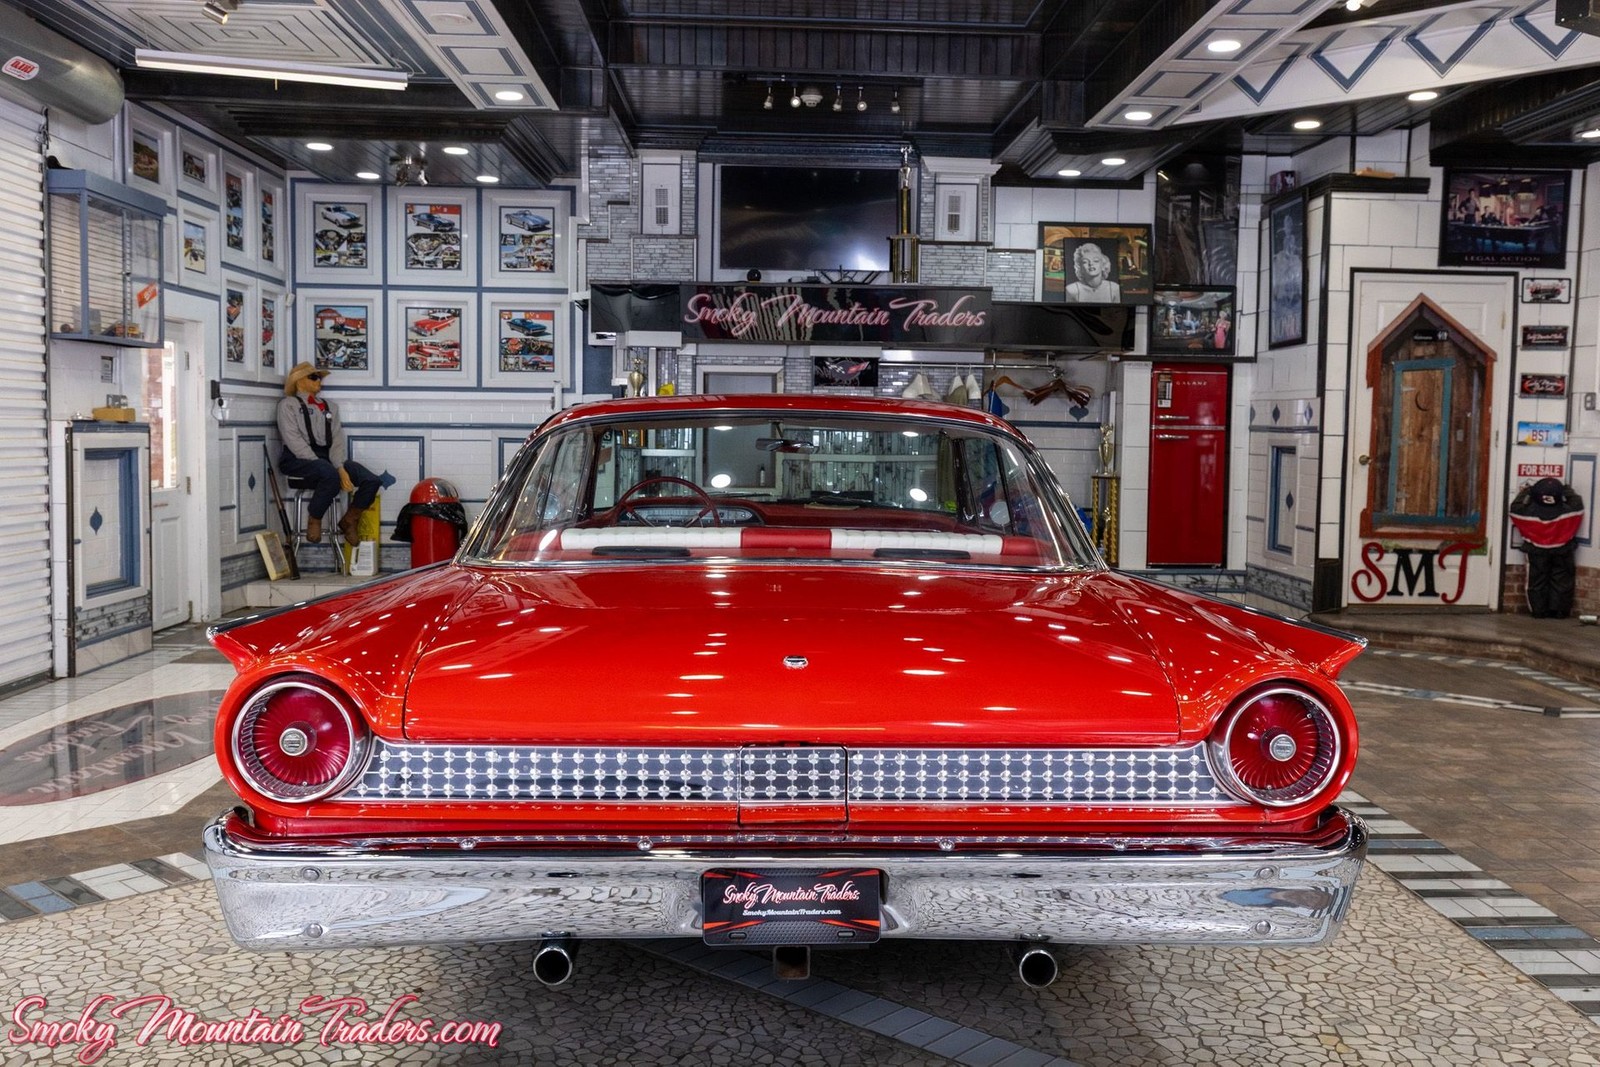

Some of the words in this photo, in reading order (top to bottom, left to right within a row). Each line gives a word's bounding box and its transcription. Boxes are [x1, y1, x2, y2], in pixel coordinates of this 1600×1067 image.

[1500, 255, 1541, 263] ACTION
[685, 293, 757, 335] Smoky
[761, 294, 889, 327] Mountain
[890, 295, 986, 331] Traders
[1531, 429, 1550, 442] BST
[1520, 465, 1538, 476] FOR
[1539, 465, 1561, 477] SALE
[1542, 495, 1556, 505] 3
[722, 881, 759, 910] Smoky
[754, 883, 818, 905] Mountain
[814, 880, 861, 902] Traders
[742, 908, 842, 917] SmokyMountainTraders.com
